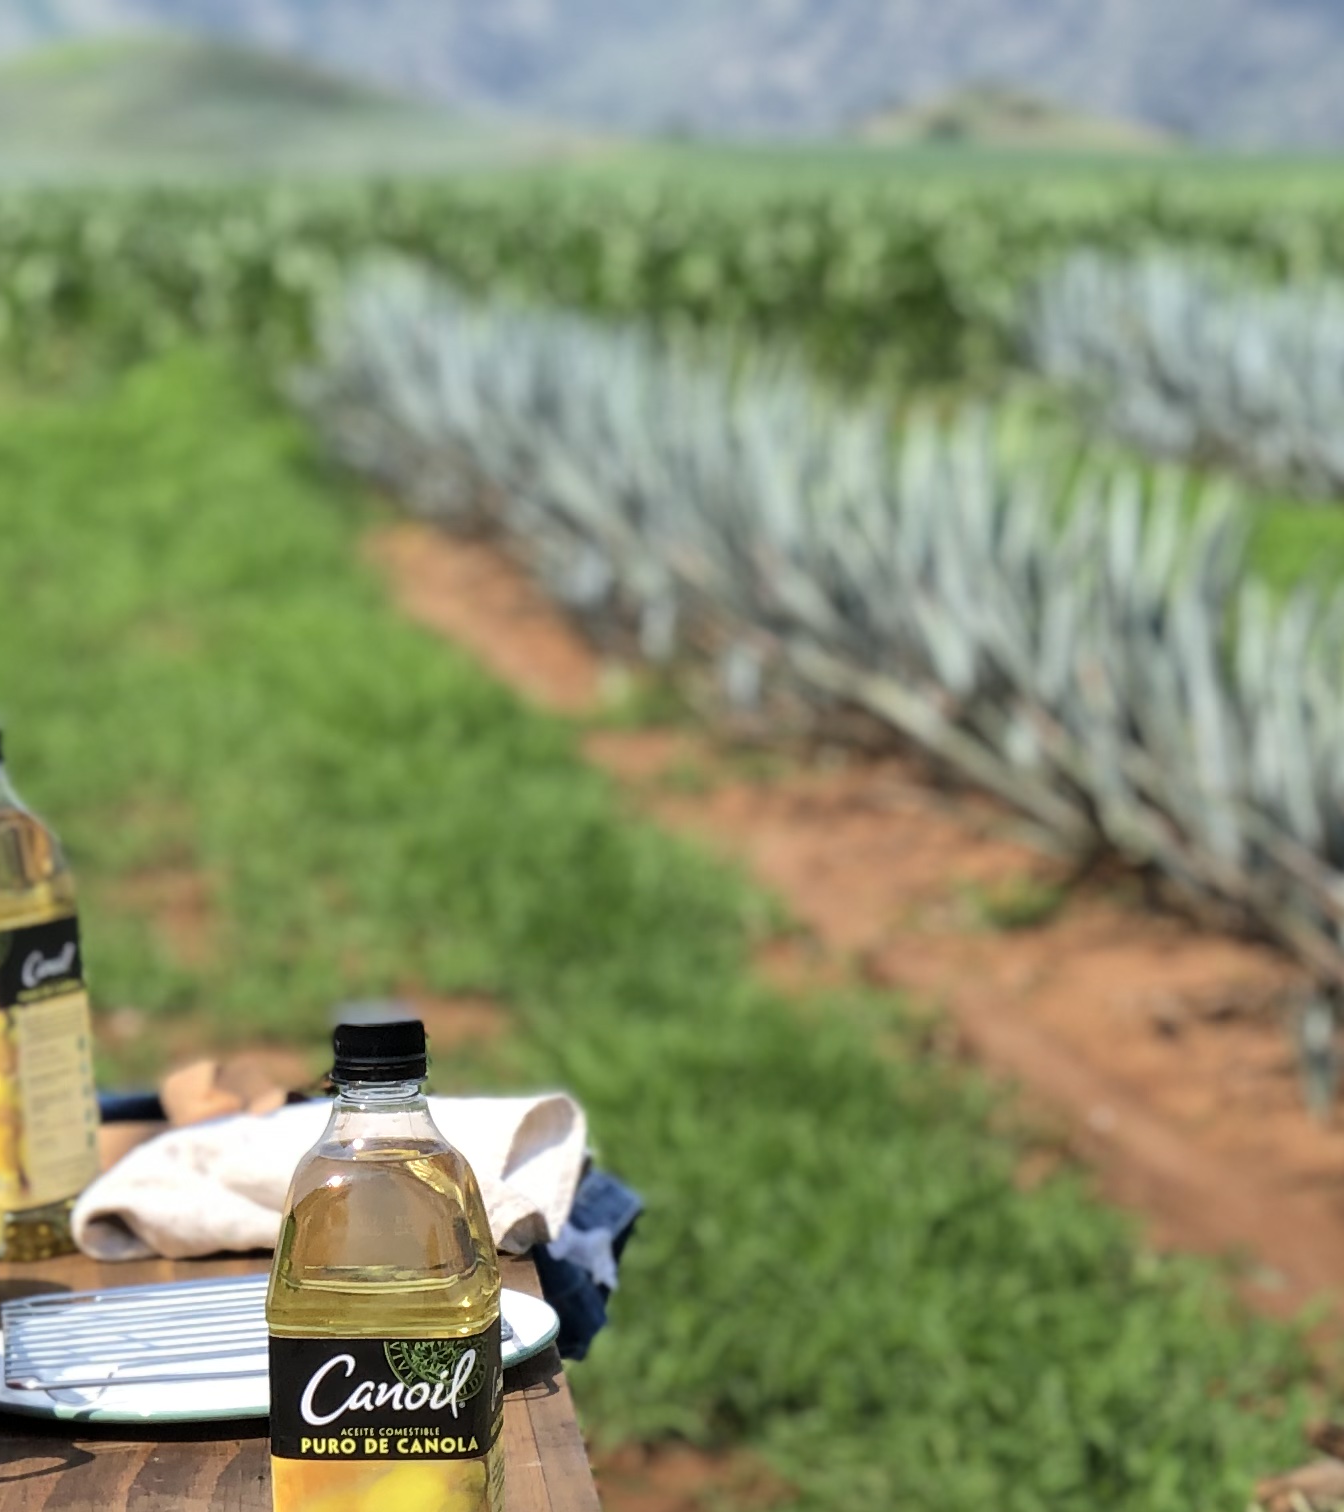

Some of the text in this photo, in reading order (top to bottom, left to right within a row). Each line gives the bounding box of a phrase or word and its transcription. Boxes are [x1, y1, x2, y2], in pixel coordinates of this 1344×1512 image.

[300, 1349, 476, 1426] Canoil
[340, 1426, 440, 1437] ACEITE COMESTIBLE
[300, 1435, 479, 1455] PURO DE CANOLA
